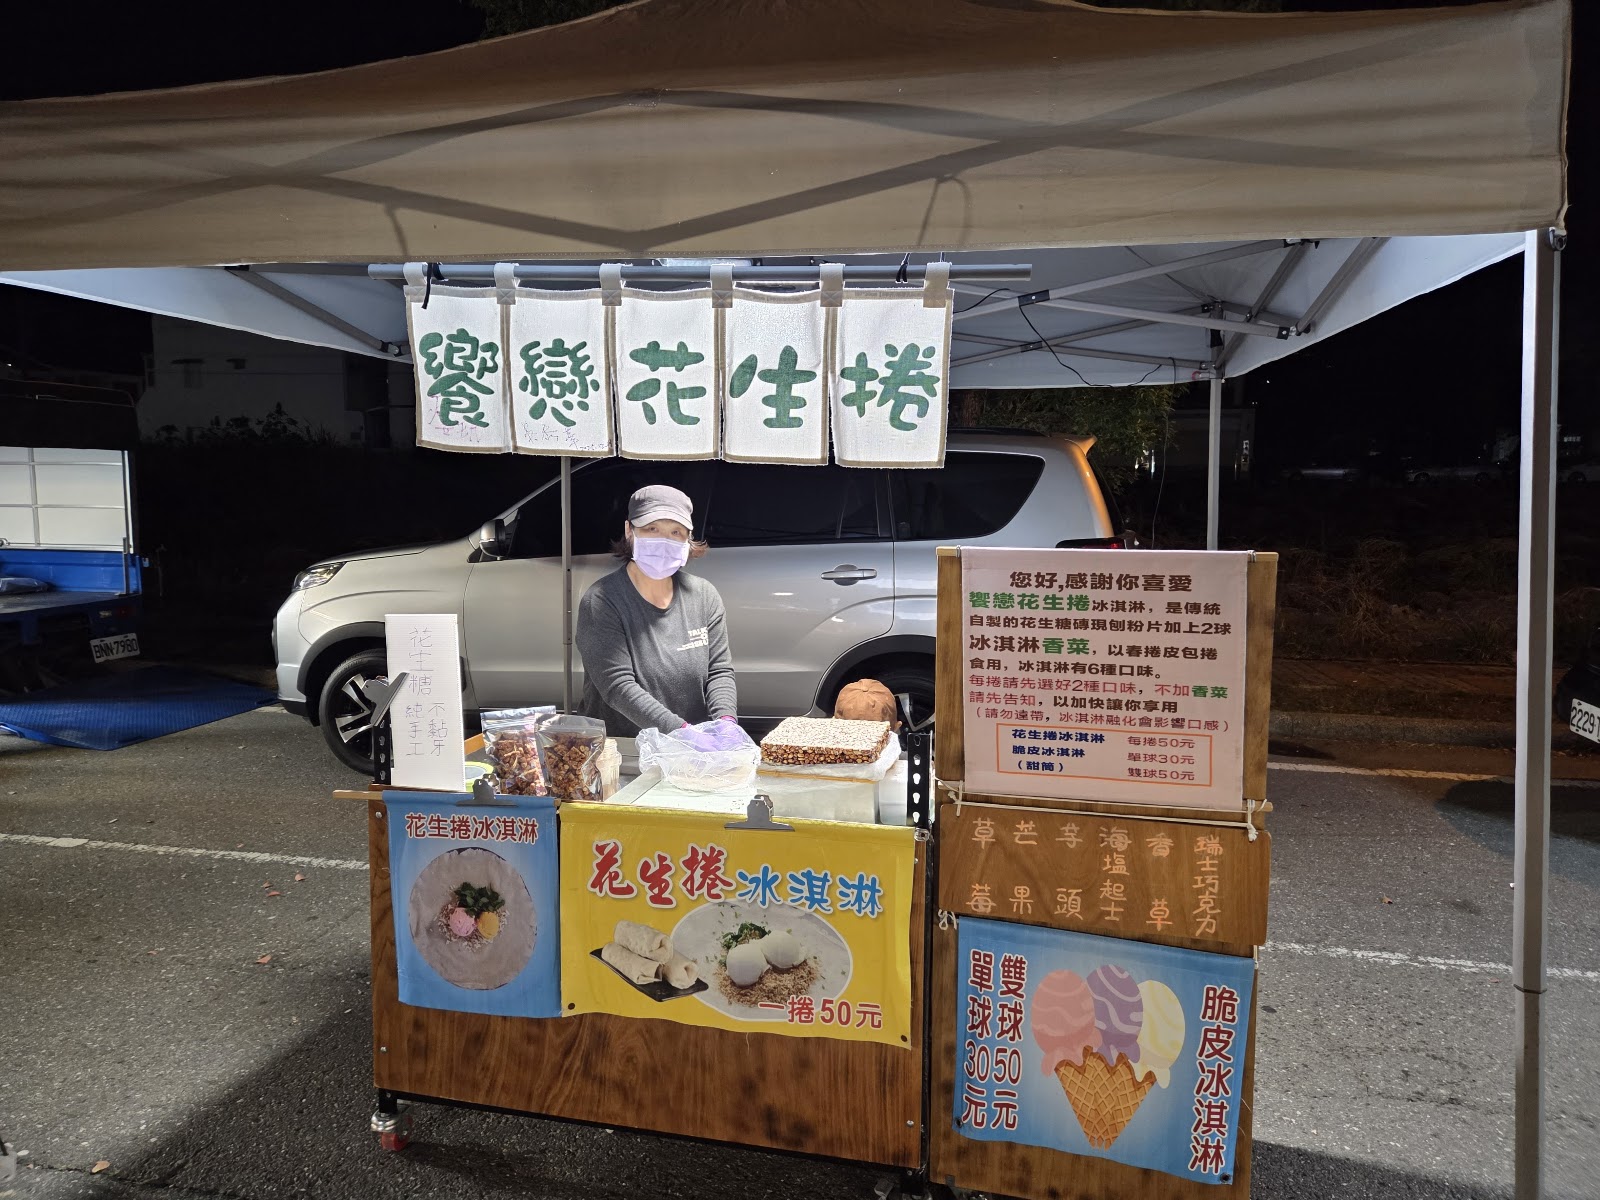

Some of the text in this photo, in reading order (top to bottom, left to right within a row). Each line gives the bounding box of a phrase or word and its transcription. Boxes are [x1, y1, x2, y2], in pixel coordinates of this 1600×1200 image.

[419, 328, 941, 431] 饗戀花生捲
[969, 614, 1232, 636] 自製的花生糖磚現刨粉片加上2球
[408, 627, 434, 696] 花生糖
[405, 702, 424, 756] 純手工
[1011, 729, 1196, 749] 花生捲冰淇淋 每捲50元
[1011, 745, 1195, 765] 脆皮冰淇淋 單球30元
[1127, 767, 1195, 781] 雙球50元
[404, 812, 539, 845] 花生捲冰淇淋
[587, 840, 884, 918] 花生捲冰淇淋
[1192, 836, 1224, 937] 瑞士巧克力
[757, 995, 883, 1030] 一捲50元
[961, 949, 995, 1129] 單球30元
[990, 953, 1028, 1131] 雙球50元
[1188, 985, 1240, 1175] 脆皮冰淇淋
